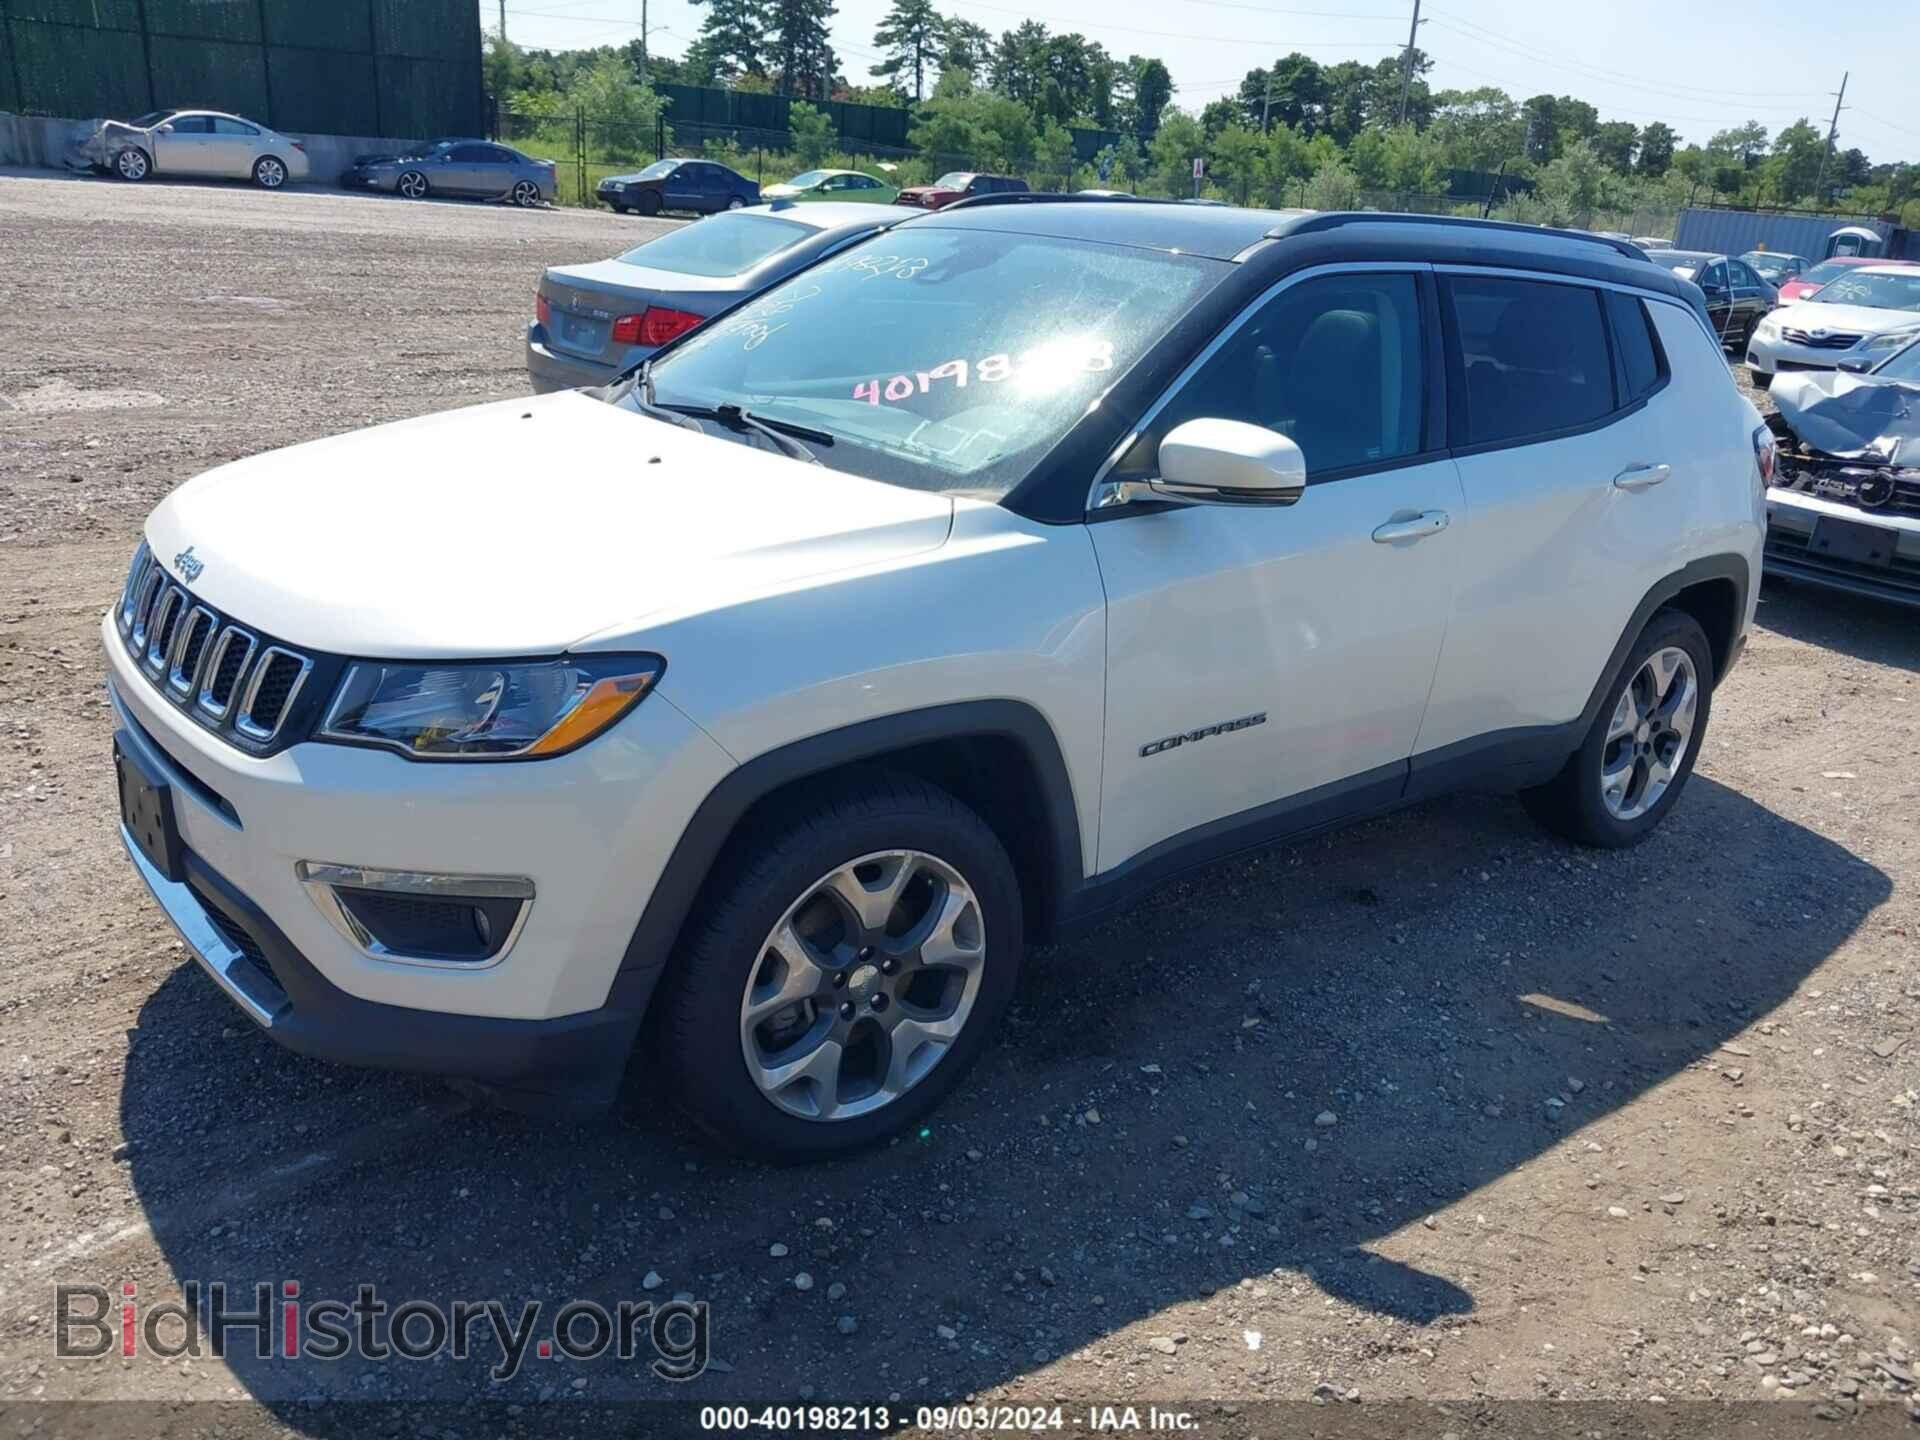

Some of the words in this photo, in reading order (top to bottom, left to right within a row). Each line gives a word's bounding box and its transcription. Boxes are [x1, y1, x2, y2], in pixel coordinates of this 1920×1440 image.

[853, 340, 1114, 407] 401983
[174, 545, 204, 586] Jeep
[1138, 711, 1268, 758] COMPASS
